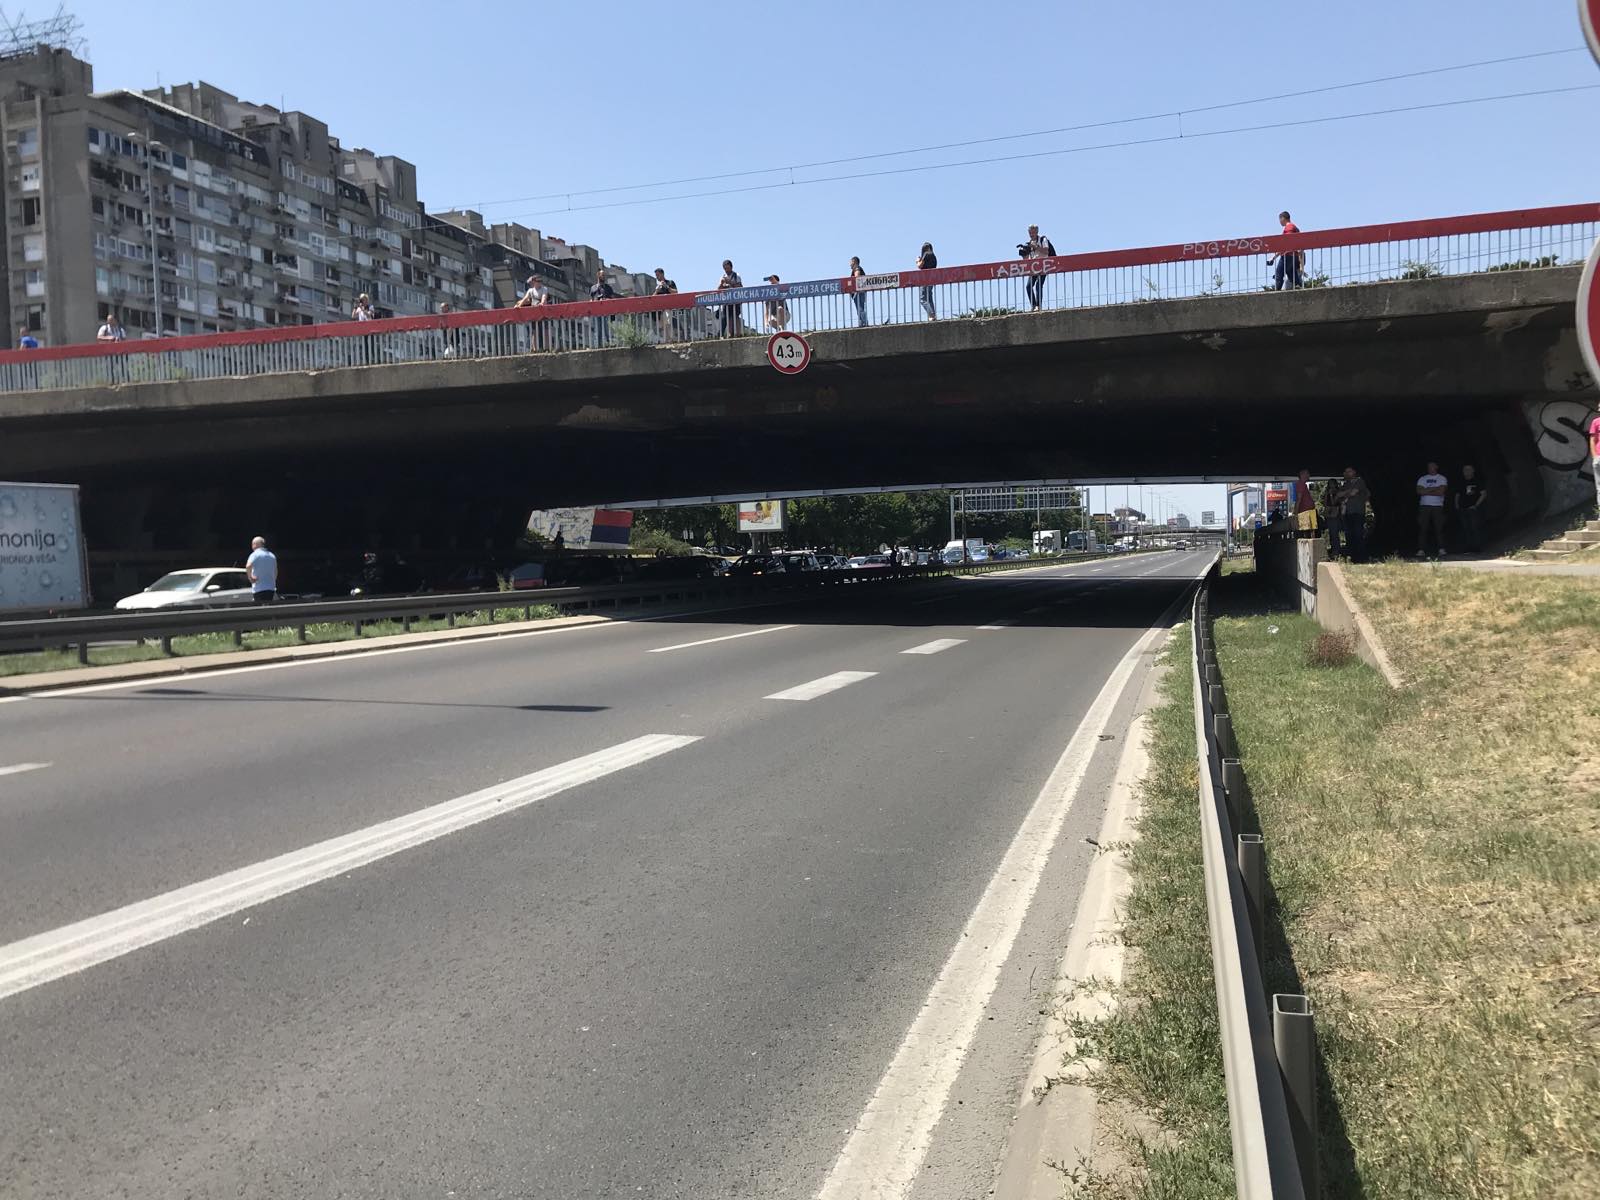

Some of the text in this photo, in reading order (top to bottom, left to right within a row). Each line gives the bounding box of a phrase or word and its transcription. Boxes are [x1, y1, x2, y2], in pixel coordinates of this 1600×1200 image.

[760, 287, 779, 298] 7763
[789, 285, 809, 295] СРБИ
[810, 285, 819, 294] ЗА
